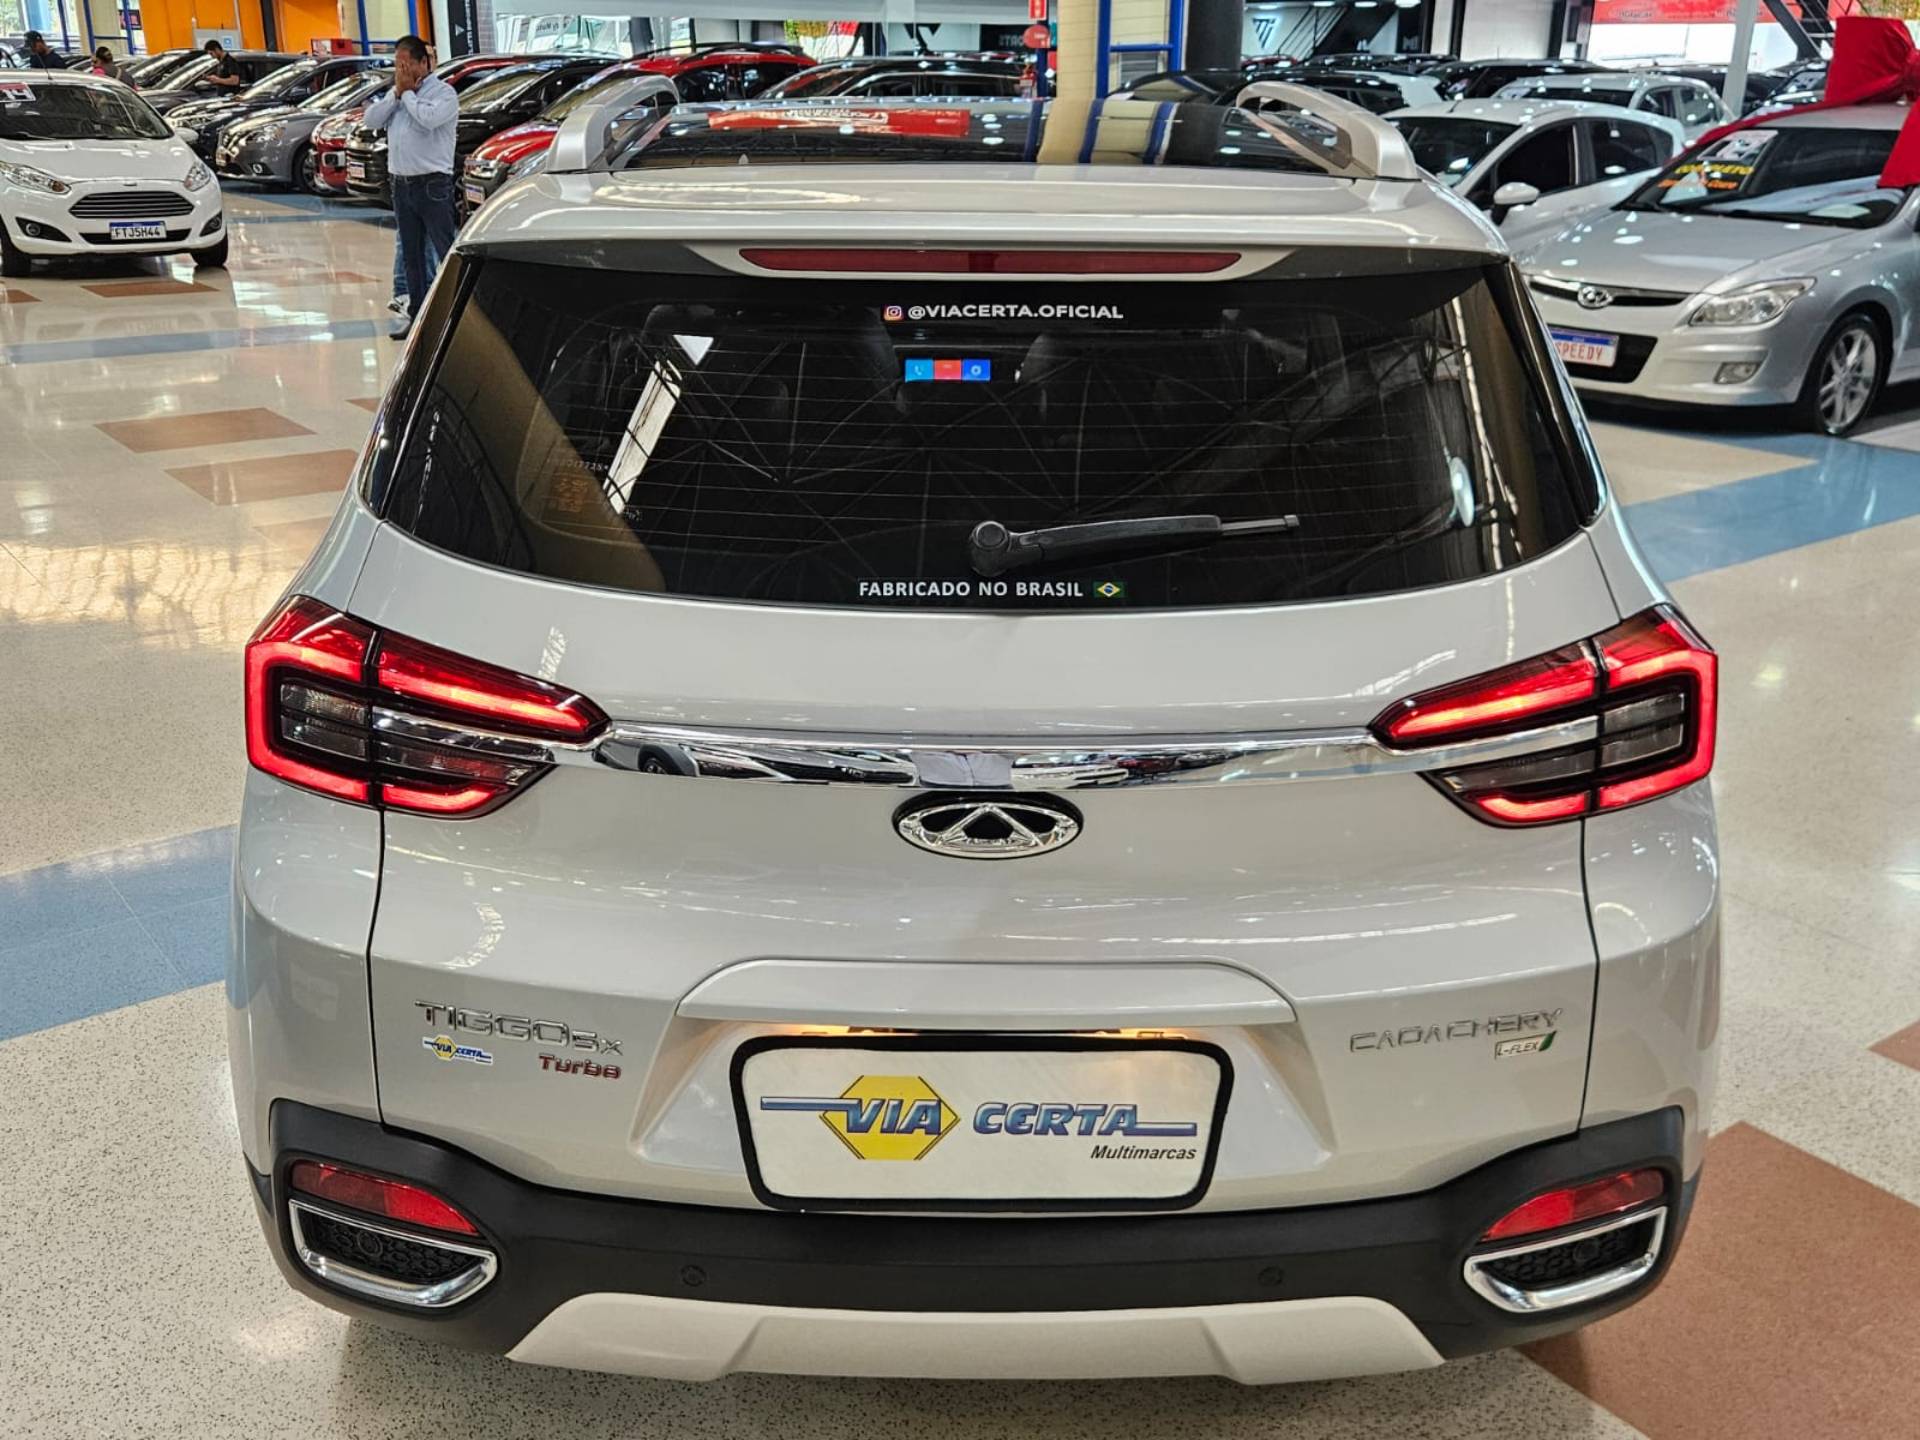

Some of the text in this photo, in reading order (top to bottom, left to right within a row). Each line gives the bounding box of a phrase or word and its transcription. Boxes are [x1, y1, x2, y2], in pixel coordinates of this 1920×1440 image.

[114, 226, 161, 239] FTJ5H44
[907, 304, 1124, 320] @VIACERTA.OFICIAL
[859, 581, 1083, 597] FABRICADO NO BRASIL
[538, 1053, 623, 1080] Turbo
[846, 1097, 1138, 1137] VIA CERTA
[1090, 1144, 1197, 1161] Multimarcas
